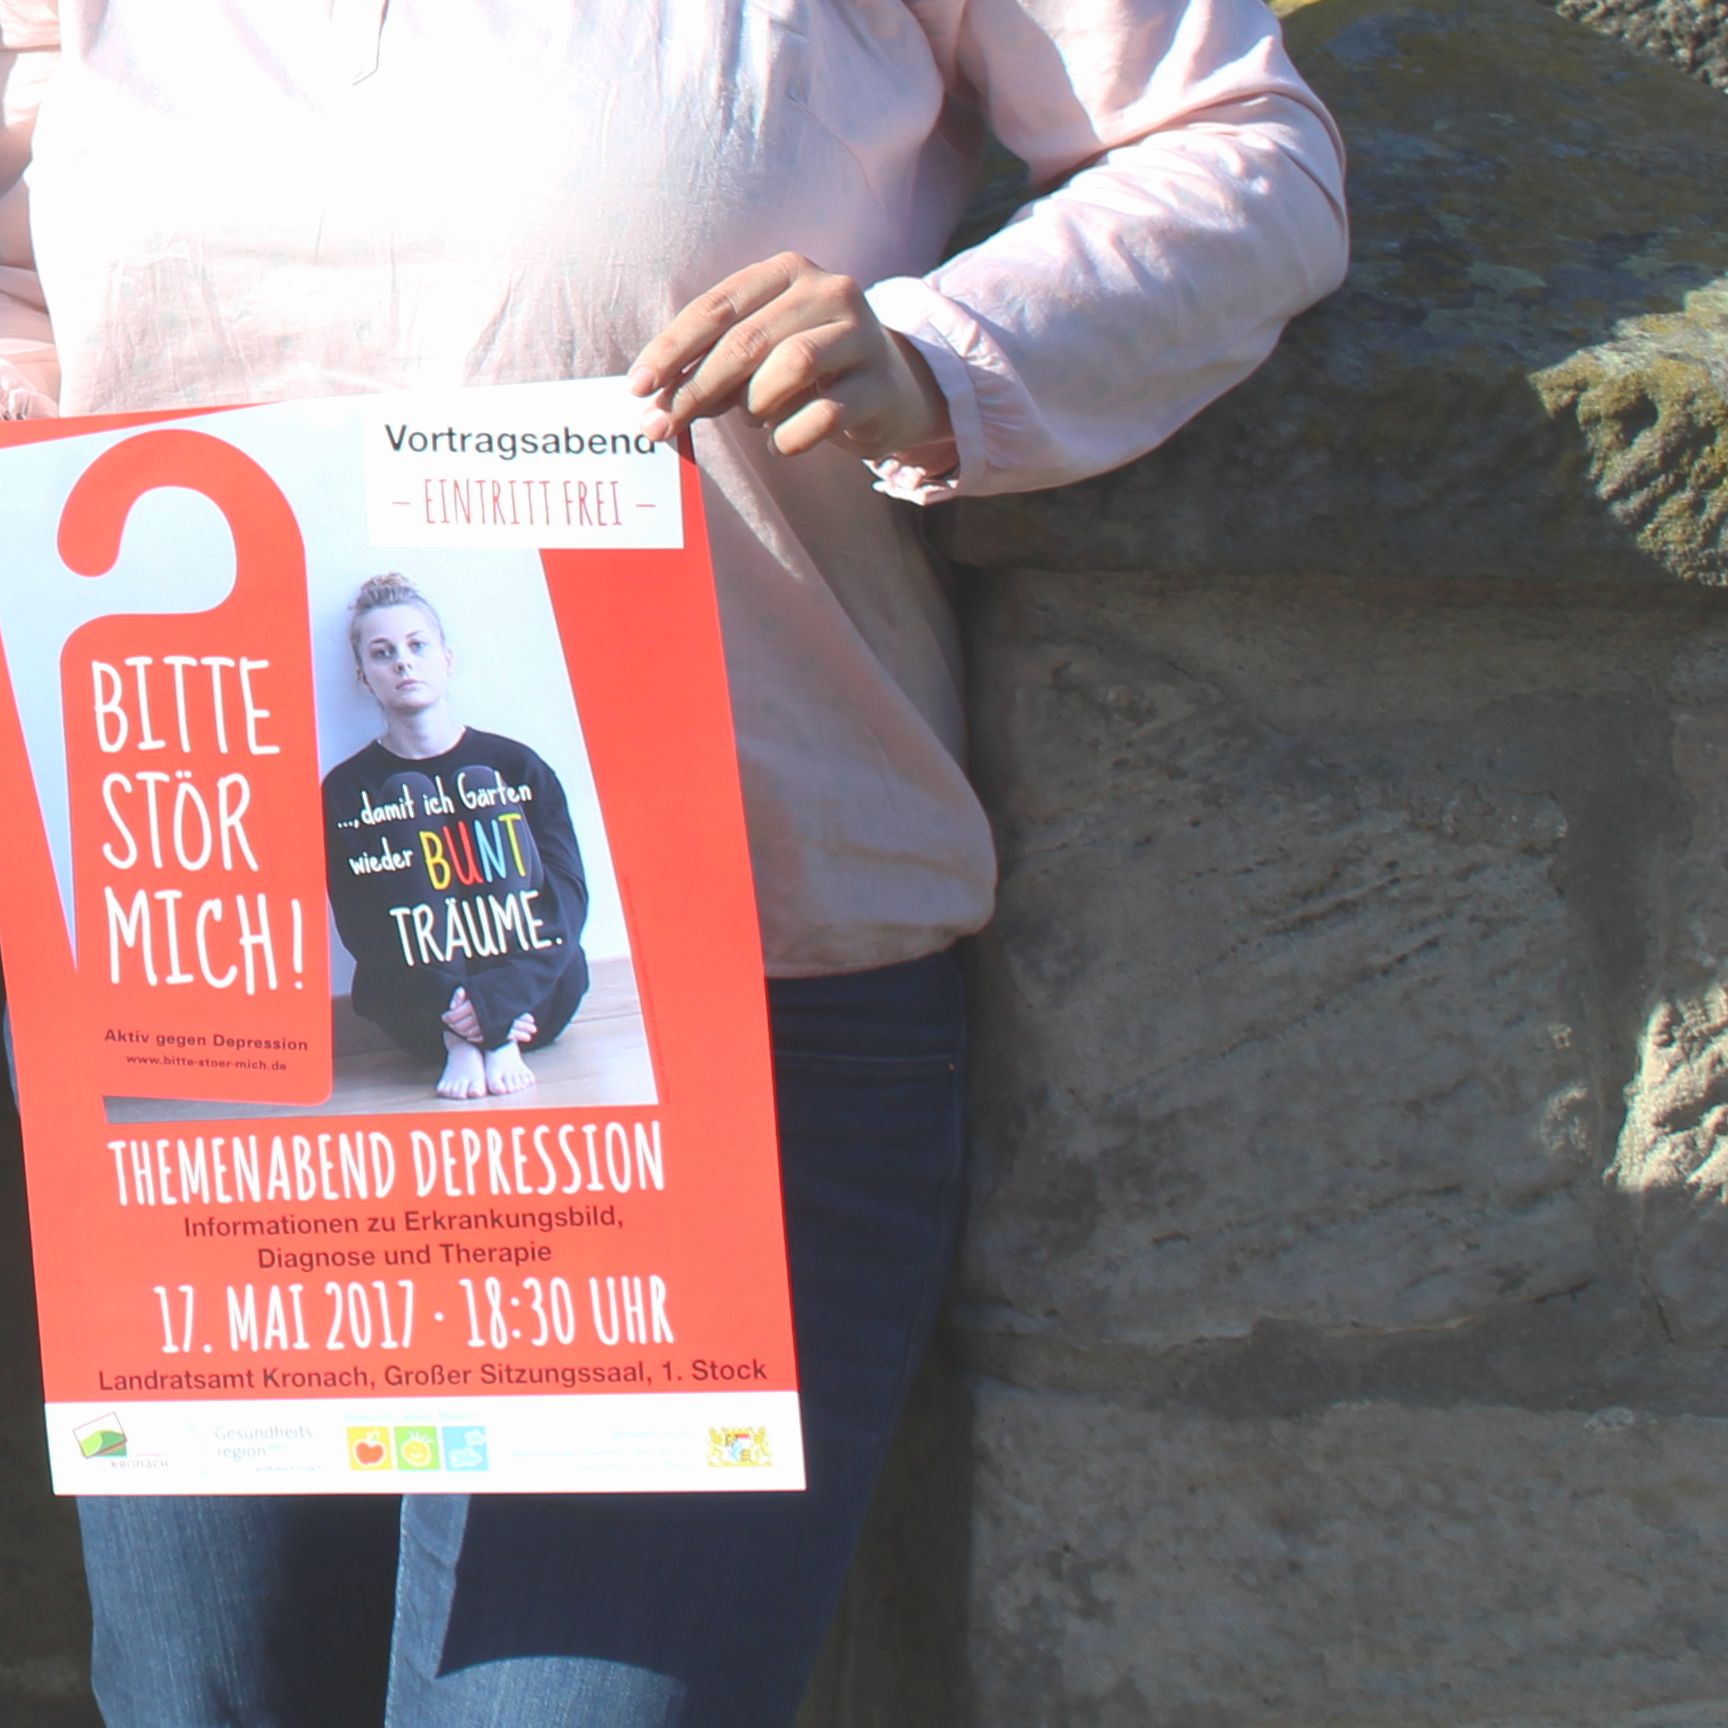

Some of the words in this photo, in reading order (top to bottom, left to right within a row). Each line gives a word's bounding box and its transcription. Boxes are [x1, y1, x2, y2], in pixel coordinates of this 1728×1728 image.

[384, 424, 656, 461] Vortragsabend
[424, 478, 550, 526] EINTRITT
[563, 480, 623, 526] FREI
[91, 655, 280, 755] BITTE
[422, 775, 455, 816] ich
[457, 770, 532, 810] Gärten
[102, 770, 259, 872] STÖR
[349, 836, 414, 876] wieder
[419, 813, 527, 890] BUNT
[104, 885, 303, 996] MICH!
[389, 890, 563, 967] TRÄUME.
[104, 1029, 149, 1043] Aktiv
[156, 1032, 206, 1048] gegen
[213, 1034, 308, 1052] Depression
[126, 1055, 287, 1071] www.bitte-stoer-mich.de
[107, 1131, 396, 1207] THEMENABEND
[410, 1120, 665, 1197] DEPRESSION
[184, 1215, 359, 1237] Informationen
[368, 1217, 396, 1232] zu
[405, 1205, 624, 1233] Erkrankungsbild,
[258, 1248, 375, 1272] Diagnose
[384, 1246, 431, 1265] und
[439, 1241, 552, 1266] Therapie
[153, 1284, 212, 1354] 17.
[226, 1283, 310, 1352] MAI
[325, 1280, 414, 1351] 2017
[459, 1276, 575, 1350] 18:30
[588, 1274, 675, 1346] UHR
[99, 1369, 254, 1391] Landratsamt
[263, 1366, 375, 1390] Kronach,
[384, 1365, 472, 1387] Großer
[480, 1360, 652, 1388] Sitzungssaal,
[662, 1362, 683, 1382] 1.
[692, 1359, 768, 1382] Stock
[215, 1425, 313, 1440] Gesundheits
